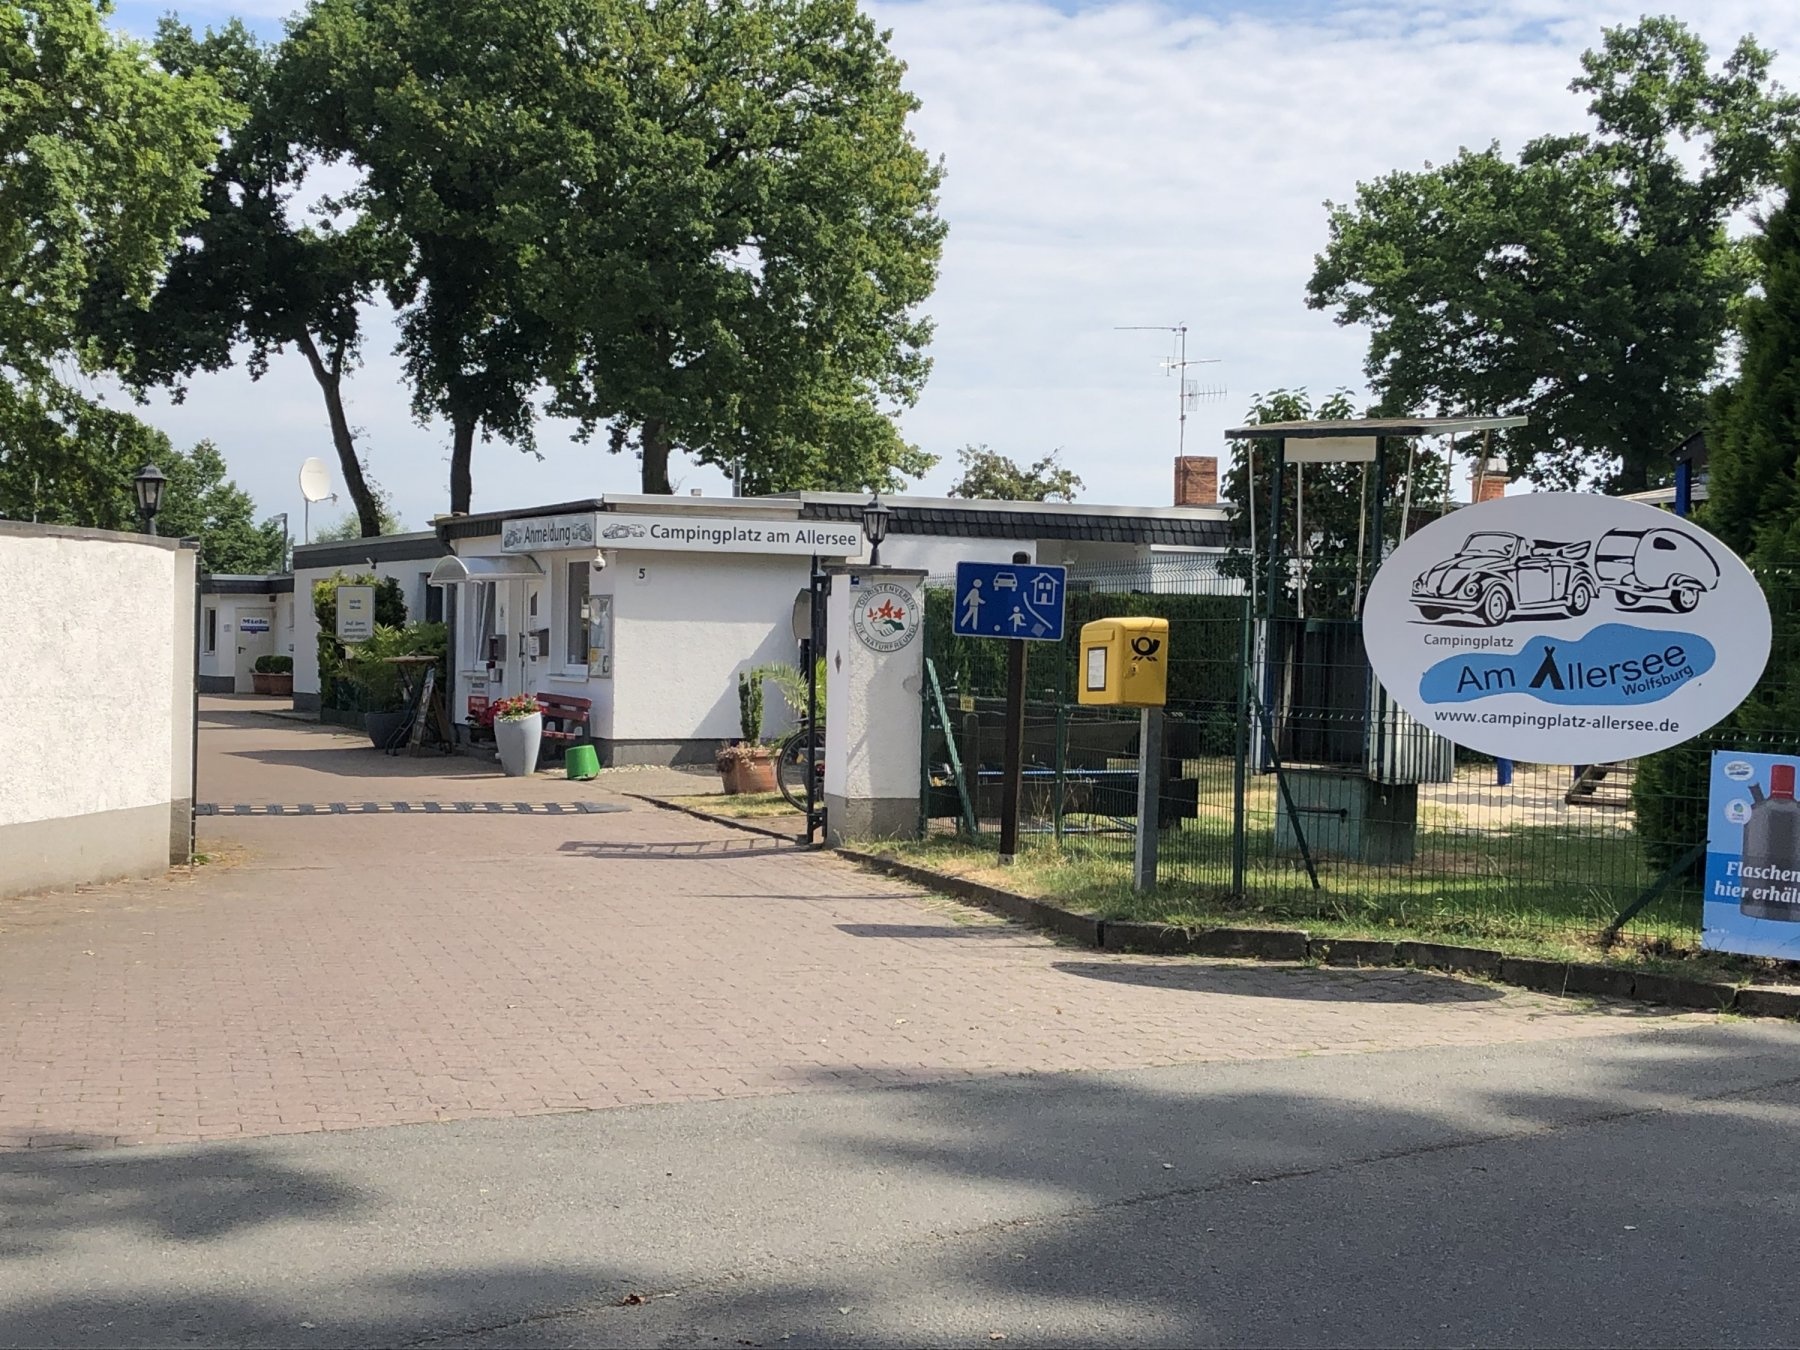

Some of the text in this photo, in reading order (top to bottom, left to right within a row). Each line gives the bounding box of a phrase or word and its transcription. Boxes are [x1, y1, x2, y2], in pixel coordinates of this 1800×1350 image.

[524, 522, 571, 546] Anmeldung
[650, 524, 856, 546] Campingplatz am Allersee
[638, 567, 646, 580] 5
[857, 584, 915, 611] TOURISTENVEREIN
[855, 621, 865, 634] DIE
[1423, 633, 1514, 649] Campingplatz
[1456, 645, 1687, 693] Am Allersee
[1622, 664, 1694, 696] Wolfsburg
[1434, 710, 1680, 733] www.campingplatz-allersee.de
[1714, 880, 1749, 898] hier
